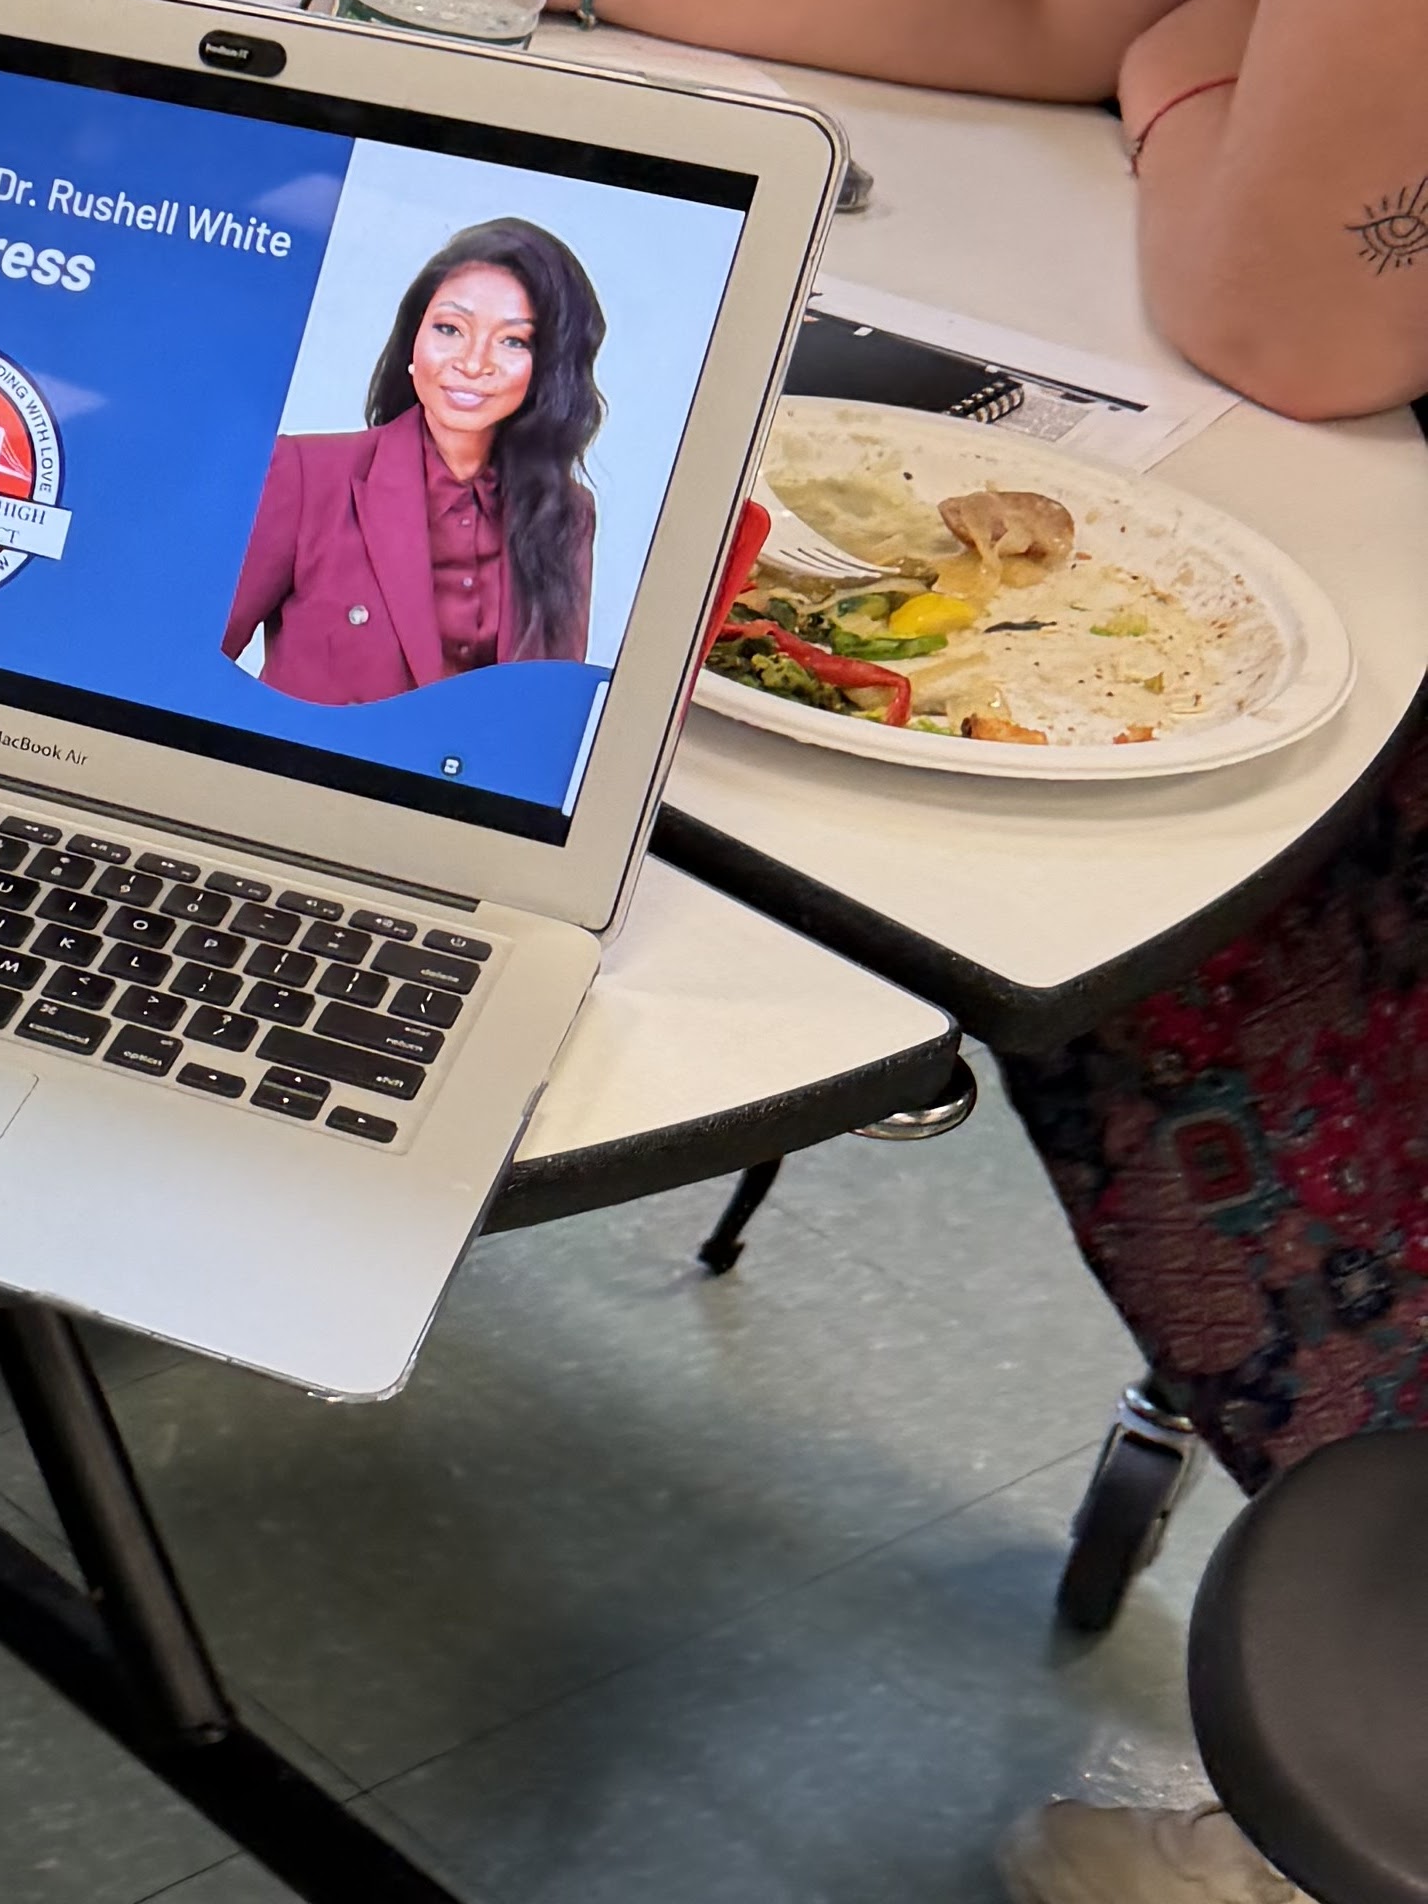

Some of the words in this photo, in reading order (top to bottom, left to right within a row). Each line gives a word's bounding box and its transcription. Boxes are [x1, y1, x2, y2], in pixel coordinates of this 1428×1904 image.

[48, 178, 179, 235] Rushell
[188, 204, 292, 258] White
[26, 400, 50, 442] WITH
[39, 446, 54, 493] LOVE
[65, 749, 89, 766] Air
